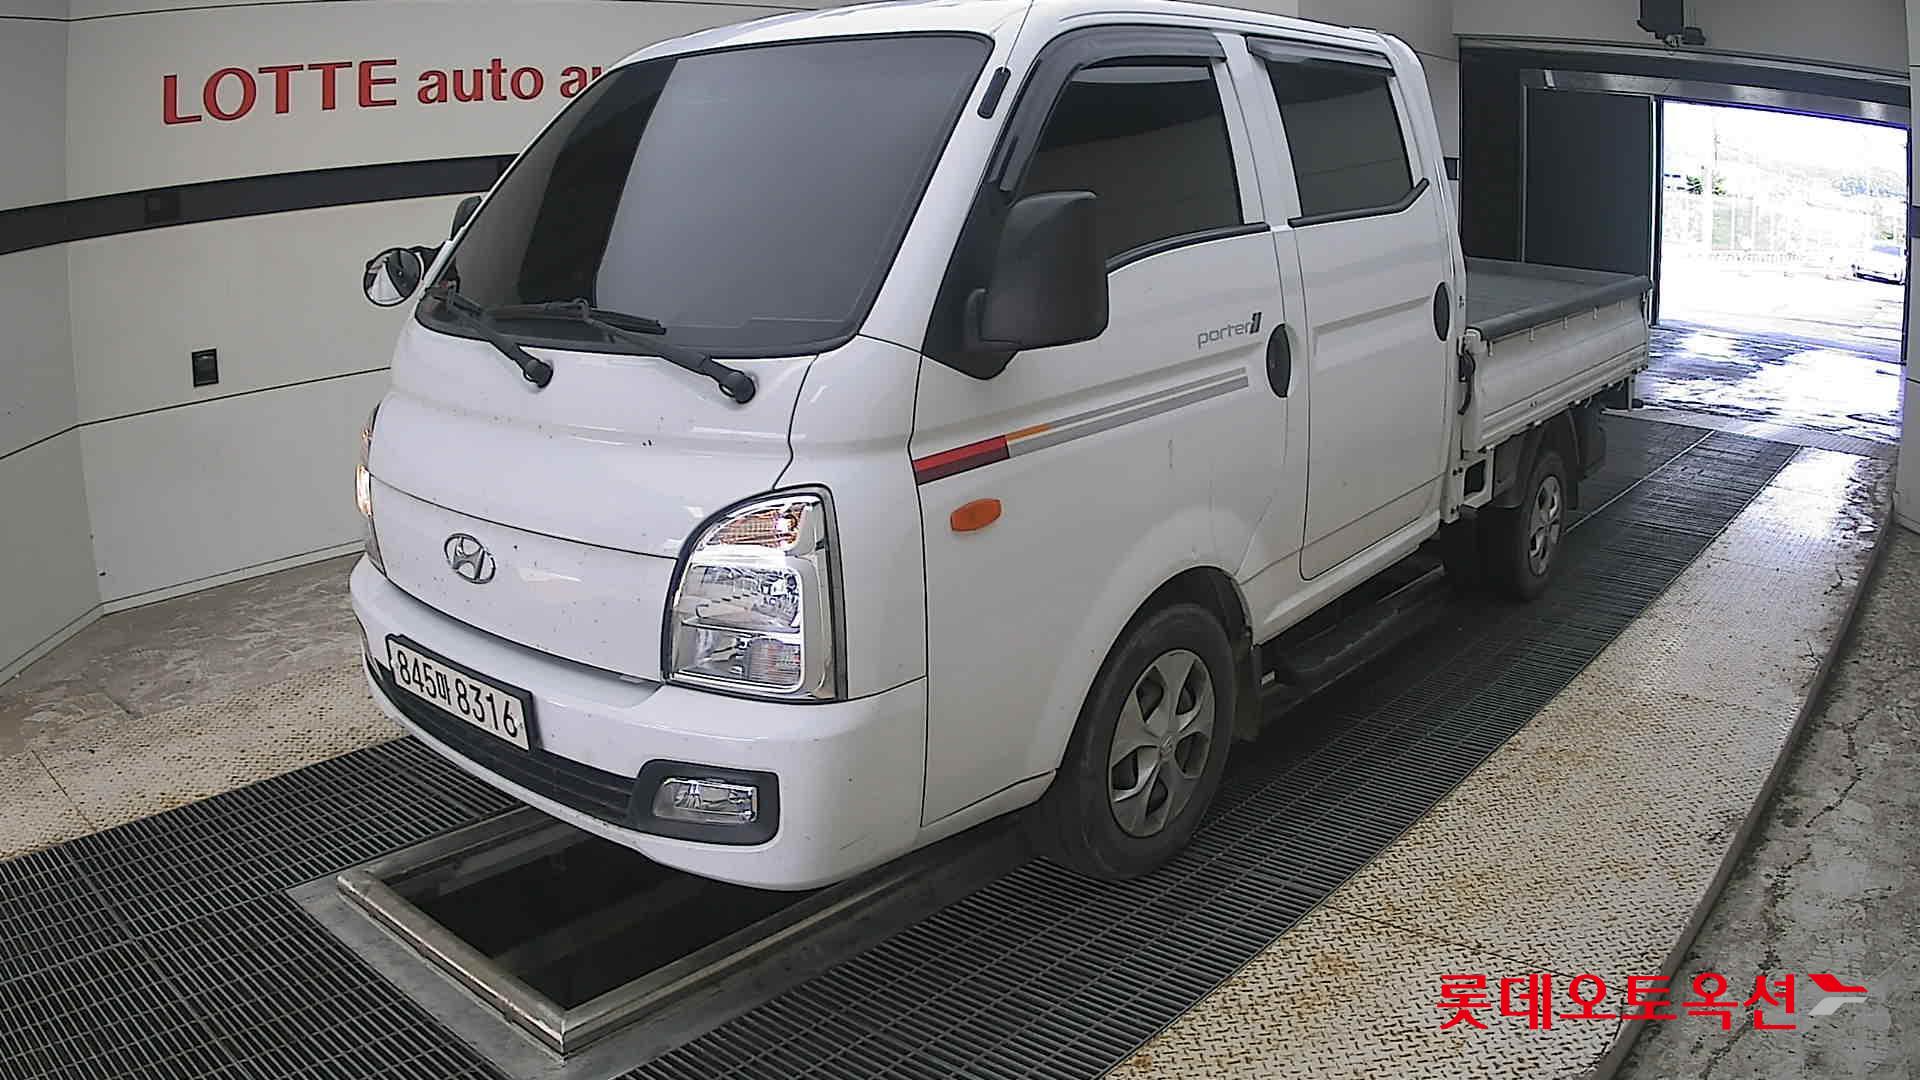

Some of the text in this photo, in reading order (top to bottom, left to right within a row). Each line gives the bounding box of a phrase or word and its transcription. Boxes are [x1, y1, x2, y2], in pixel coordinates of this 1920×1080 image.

[163, 58, 398, 125] LOTTE
[416, 57, 544, 105] auto
[397, 650, 518, 738] 845마 8316
